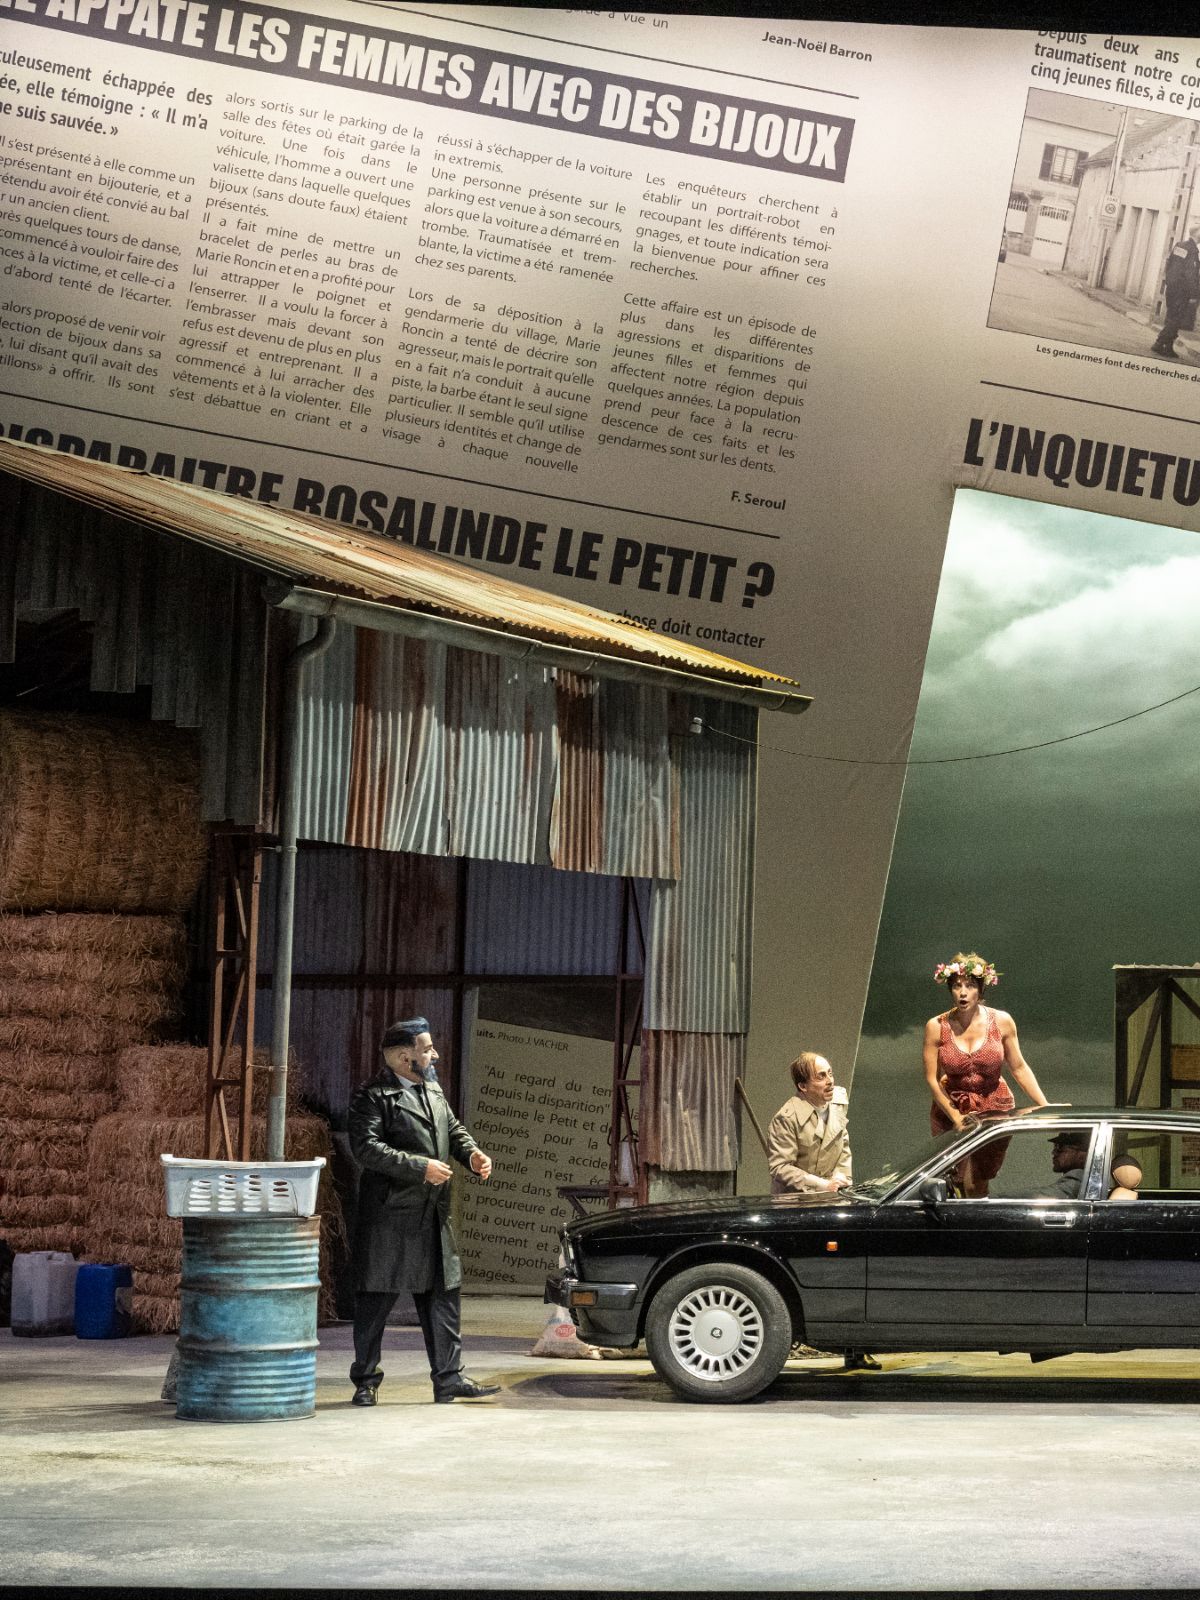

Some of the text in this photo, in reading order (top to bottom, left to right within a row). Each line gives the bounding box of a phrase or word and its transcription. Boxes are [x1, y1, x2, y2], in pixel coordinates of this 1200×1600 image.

[623, 13, 646, 25] vue
[653, 18, 669, 29] un
[762, 32, 872, 62] Jean-Noël Barron
[1035, 42, 1126, 73] traumatisent
[1134, 65, 1172, 82] notre
[1104, 36, 1140, 56] deux
[1154, 49, 1180, 64] ans
[0, 49, 213, 106] uleusement échappée des
[214, 8, 290, 63] LES
[297, 24, 475, 100] FEMMES
[479, 61, 592, 122] AVEC
[599, 84, 682, 140] DES
[689, 100, 842, 170] BIJOUX
[1031, 62, 1061, 84] cinq
[1062, 67, 1112, 90] jeunes
[1116, 78, 1153, 101] filles,
[1156, 86, 1165, 101] à
[1170, 92, 1184, 104] ce
[16, 106, 46, 122] suis
[50, 113, 106, 134] sauvée.
[26, 80, 54, 98] elle
[61, 88, 133, 115] témoigne
[166, 108, 176, 124] Il
[182, 114, 208, 130] m'a
[226, 92, 424, 140] alors sortis sur le parking de la
[223, 110, 420, 156] salle des fêtes où était garée la
[437, 134, 632, 180] réussi à s'échapper de la voiture
[646, 172, 838, 218] Les enquêteurs cherchent à
[642, 190, 835, 236] établir un portrait-robot en
[1036, 344, 1051, 354] Les
[1052, 349, 1102, 364] gendarmes
[1104, 356, 1123, 368] font
[1124, 361, 1140, 371] des
[1142, 366, 1189, 380] recherches
[731, 490, 786, 510] F. Seroul
[293, 478, 547, 570] ROSALINDE
[553, 527, 604, 580] LE
[609, 537, 737, 603] PETIT
[662, 618, 691, 635] doit
[696, 626, 765, 648] contacter
[498, 1032, 524, 1044] Photo
[534, 1037, 568, 1051] VACHER
[480, 1083, 522, 1100] depuis
[525, 1090, 536, 1102] la
[514, 1074, 556, 1088] regard
[565, 1080, 582, 1092] du
[477, 1100, 596, 1132] Rosaline le Petit et
[473, 1120, 598, 1150] déployés pour la
[478, 1140, 516, 1155] ucune
[526, 1149, 558, 1163] piste,
